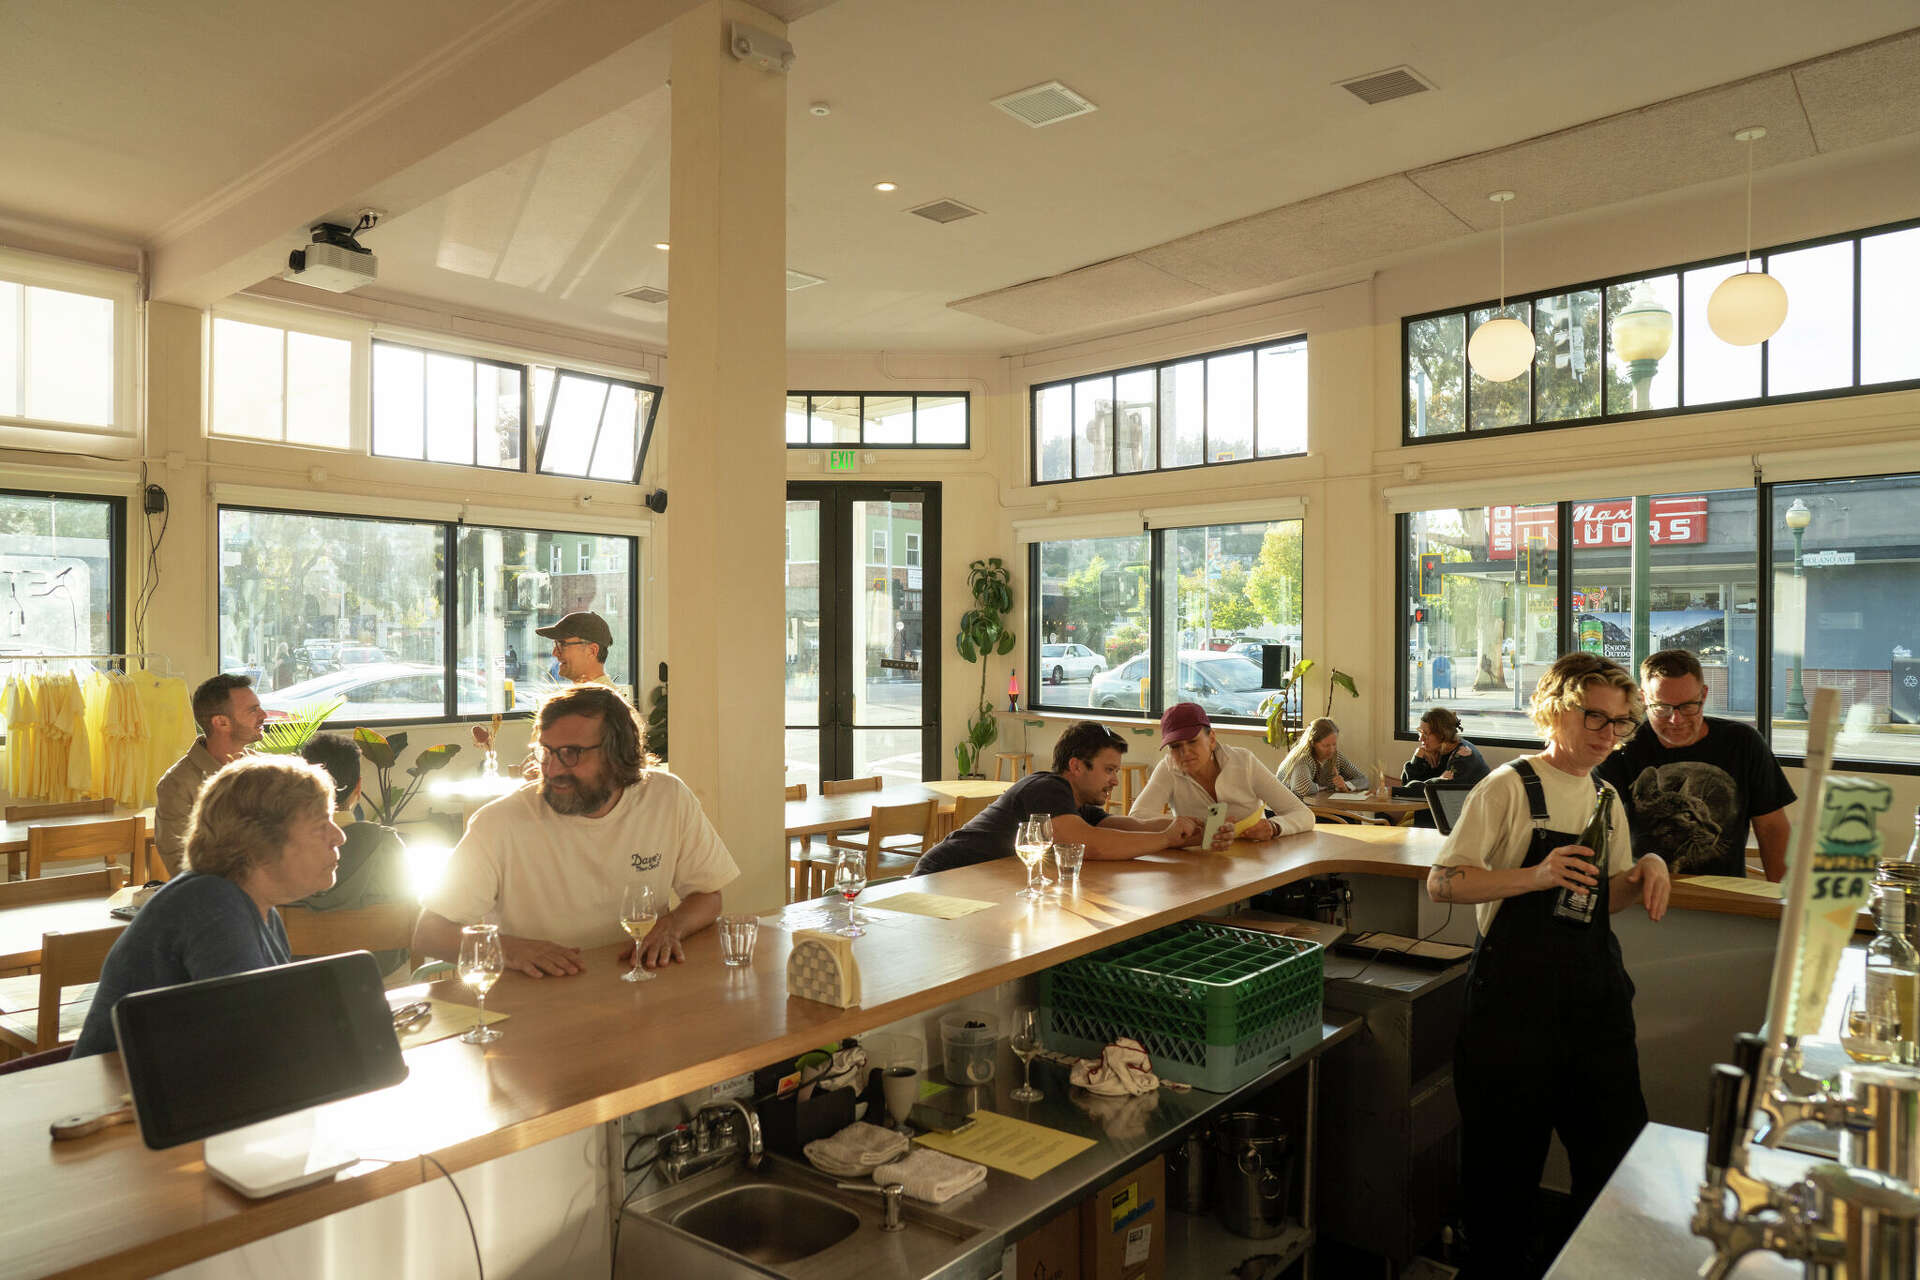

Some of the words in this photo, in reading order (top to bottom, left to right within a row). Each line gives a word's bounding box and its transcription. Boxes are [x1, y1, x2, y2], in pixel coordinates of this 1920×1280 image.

[831, 451, 855, 469] EXIT
[1523, 519, 1690, 547] LIUORS
[1804, 555, 1836, 564] SOLANO
[1838, 555, 1852, 564] AVE
[1605, 643, 1626, 651] ENJOY
[631, 853, 661, 867] Dave's
[1812, 876, 1864, 899] SEA
